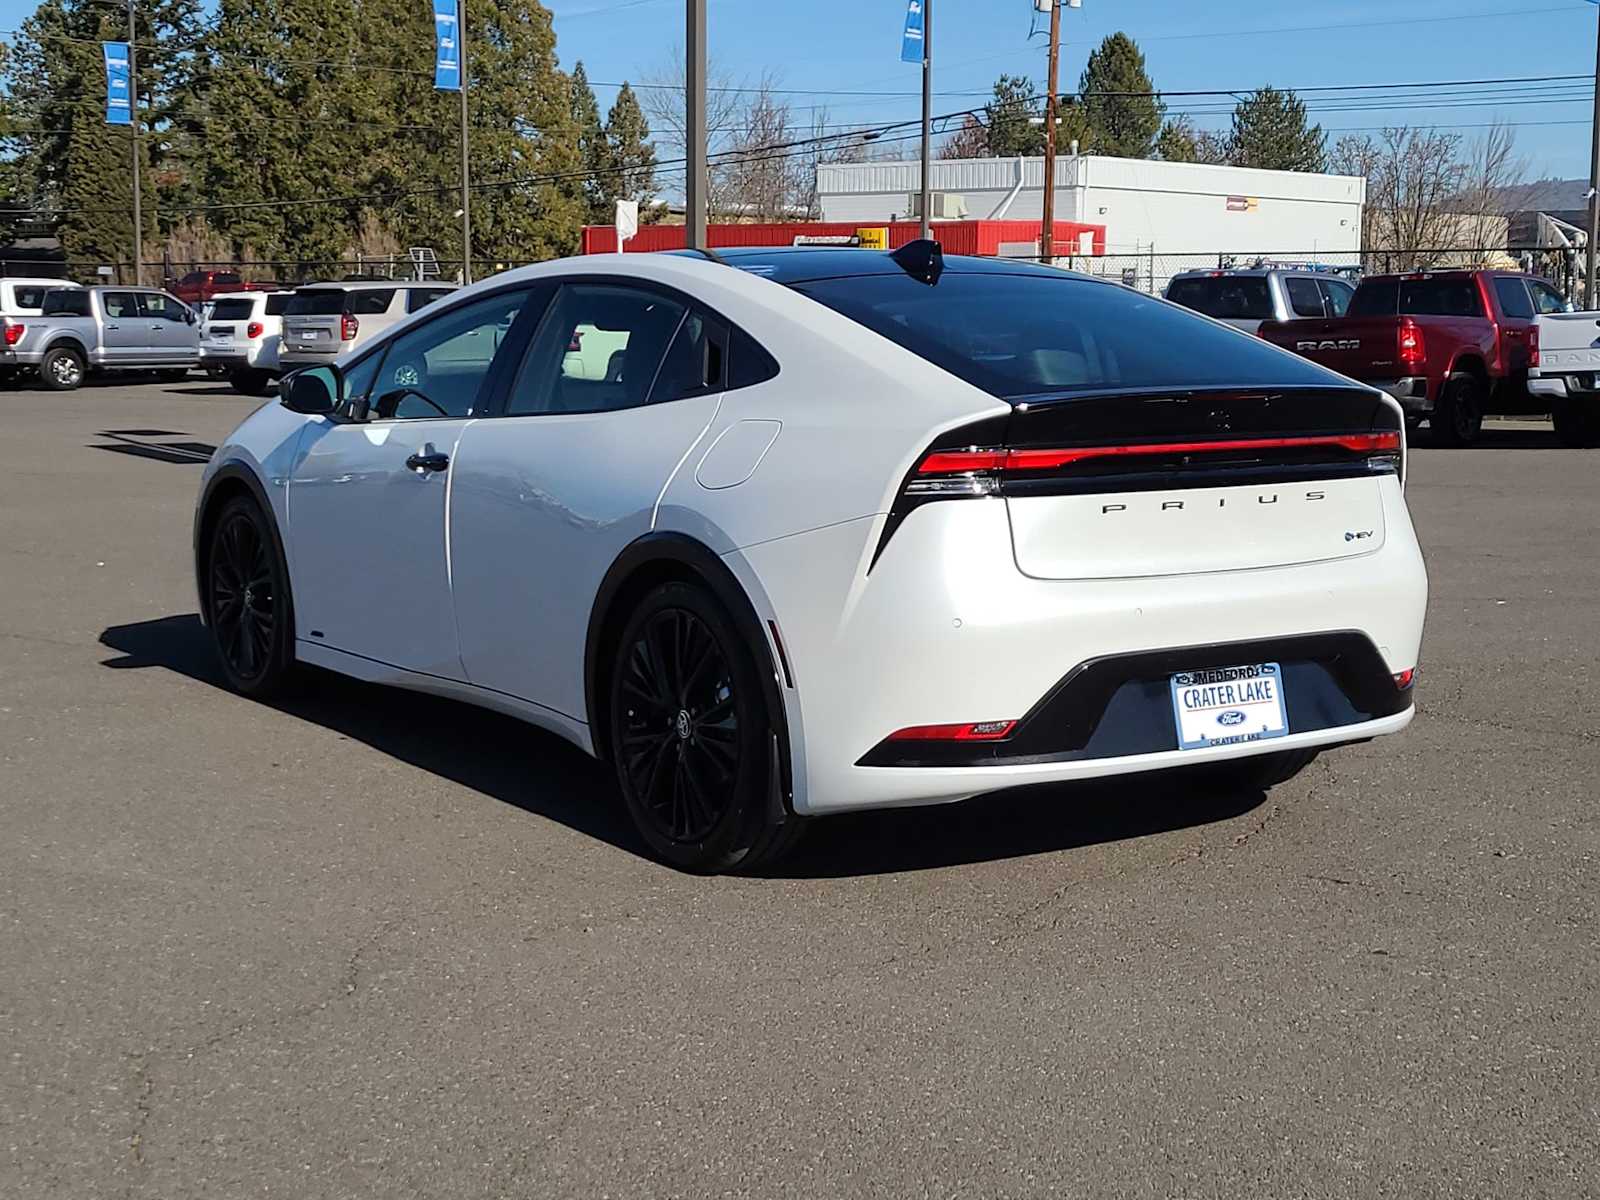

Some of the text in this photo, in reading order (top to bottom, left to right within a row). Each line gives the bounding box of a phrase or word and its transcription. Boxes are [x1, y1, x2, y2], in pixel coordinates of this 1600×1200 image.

[1296, 340, 1360, 350] RAM
[1102, 491, 1326, 514] PRIUS
[1197, 666, 1255, 685] MEDFORD
[1183, 680, 1273, 708] CRATER LAKE
[1220, 711, 1243, 725] Ford
